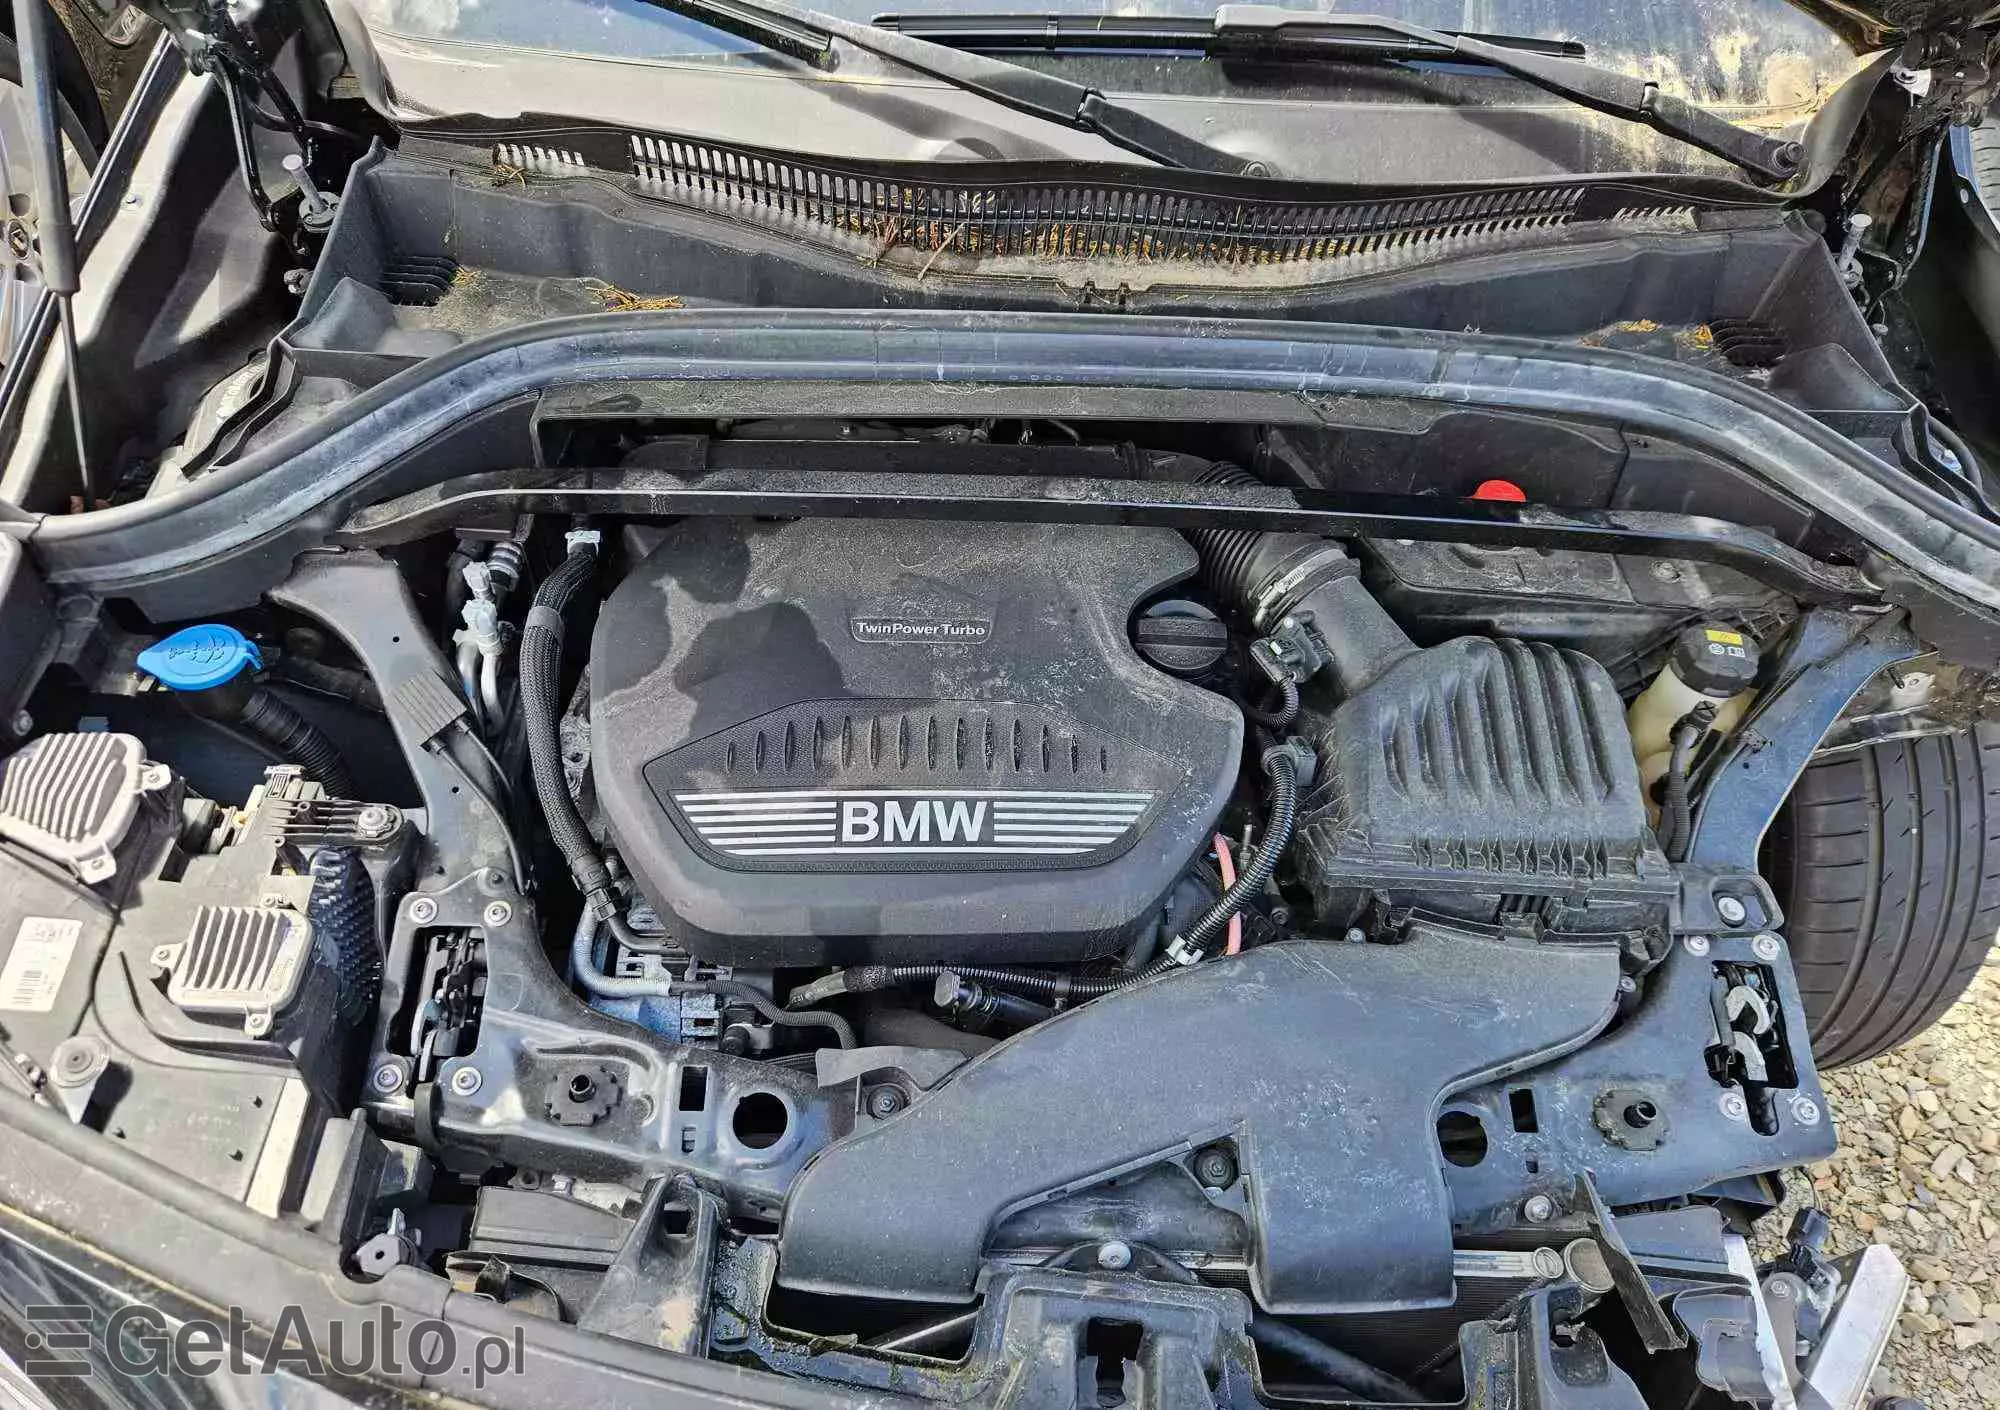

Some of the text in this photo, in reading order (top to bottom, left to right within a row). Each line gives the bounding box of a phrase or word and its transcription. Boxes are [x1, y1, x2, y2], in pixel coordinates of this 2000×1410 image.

[856, 622, 986, 636] TwinPower Turbo
[842, 800, 988, 842] BMW
